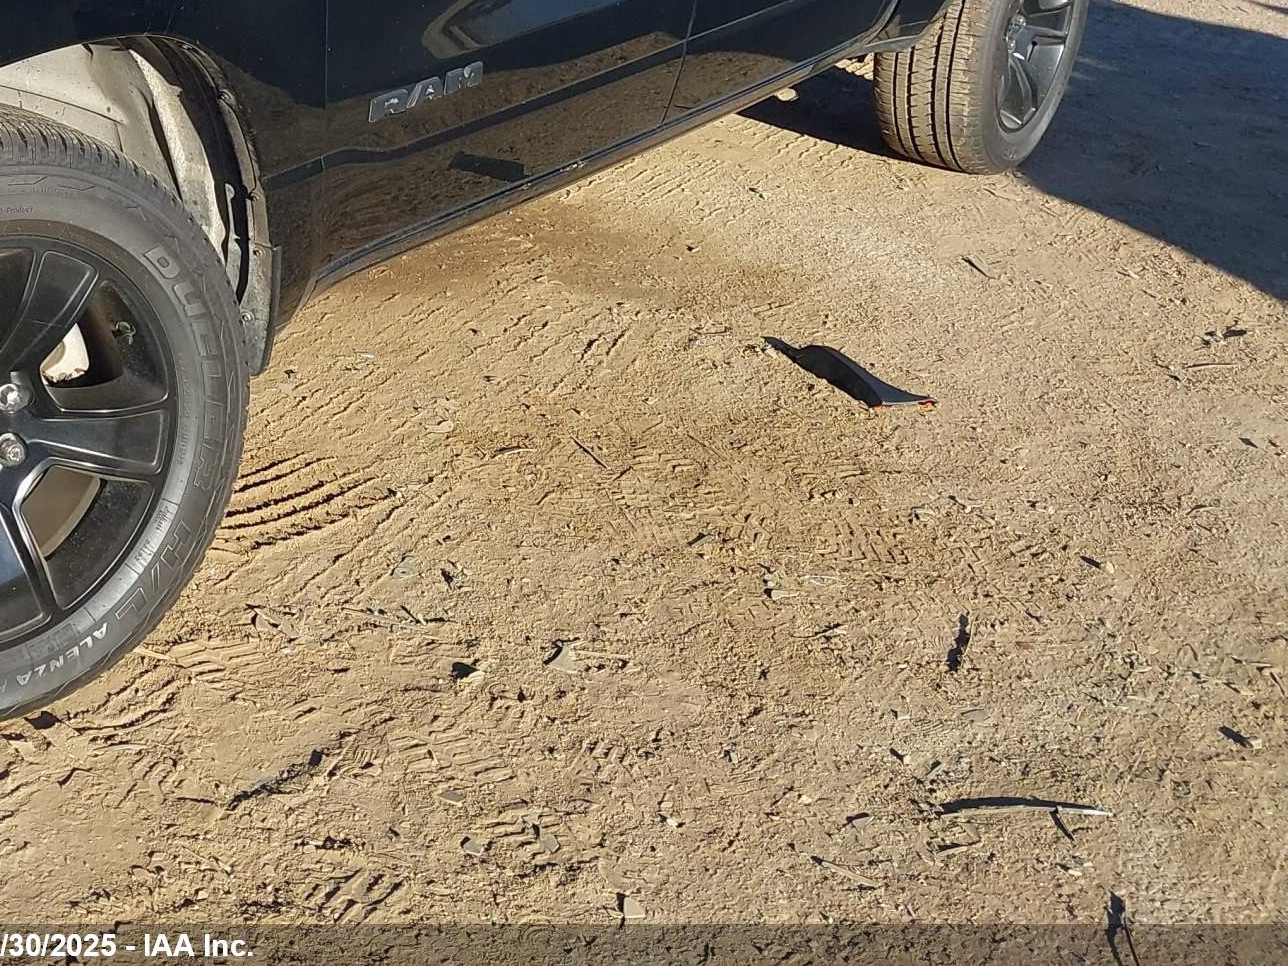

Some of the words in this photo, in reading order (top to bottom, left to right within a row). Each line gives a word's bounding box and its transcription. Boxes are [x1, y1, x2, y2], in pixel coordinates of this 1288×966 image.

[368, 60, 484, 123] RAM
[142, 242, 227, 490] DUELER
[16, 621, 109, 686] ALENZA
